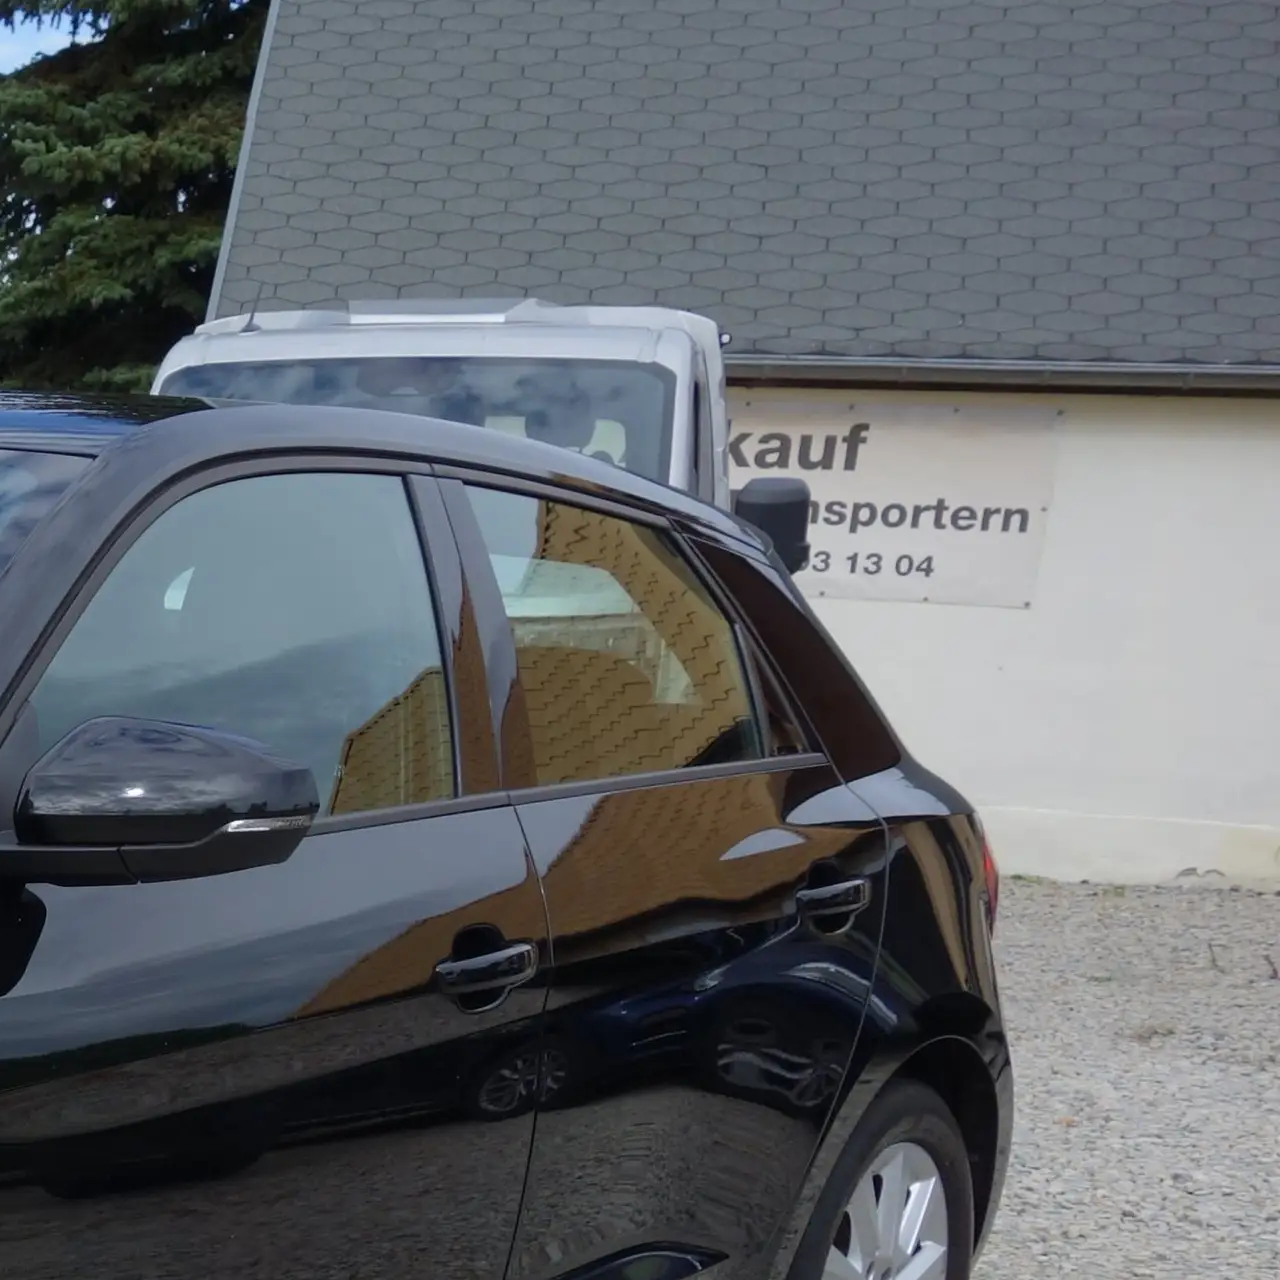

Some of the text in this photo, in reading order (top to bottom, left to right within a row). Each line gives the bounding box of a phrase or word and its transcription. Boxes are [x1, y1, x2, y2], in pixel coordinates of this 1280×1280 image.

[727, 421, 870, 471] kauf
[799, 550, 934, 577] 3 13 04
